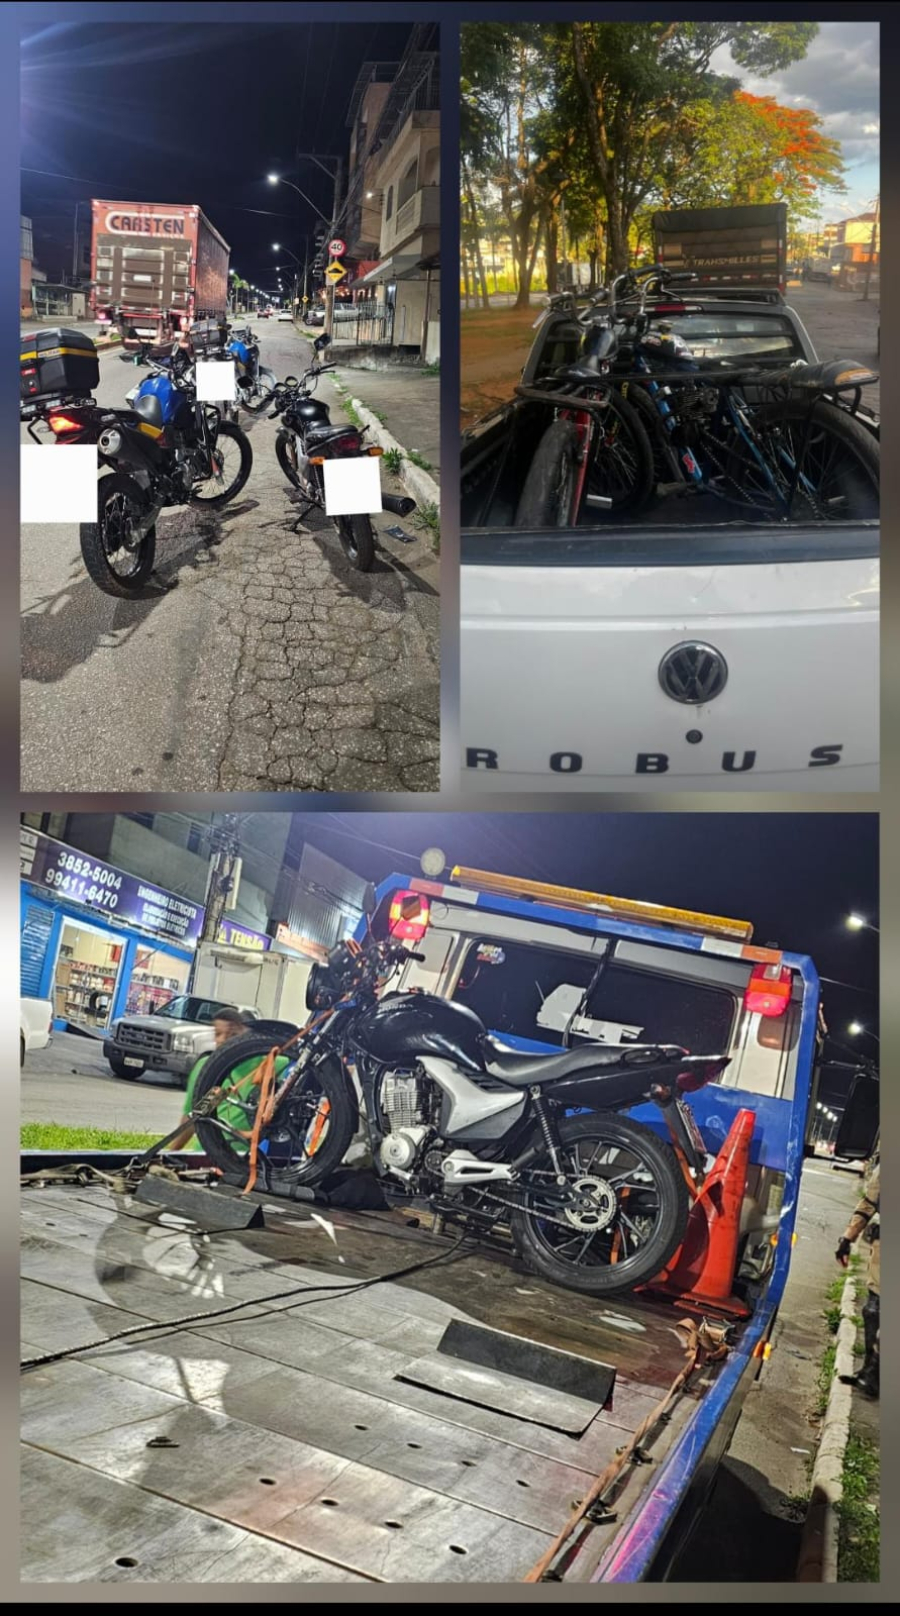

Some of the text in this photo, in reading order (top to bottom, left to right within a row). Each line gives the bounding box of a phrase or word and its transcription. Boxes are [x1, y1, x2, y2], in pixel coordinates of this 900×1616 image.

[110, 214, 185, 235] CARSTEN
[331, 243, 342, 251] 40
[57, 851, 123, 891] 3852-5004
[45, 868, 119, 908] 99411-6470
[230, 928, 265, 951] TENSÃO
